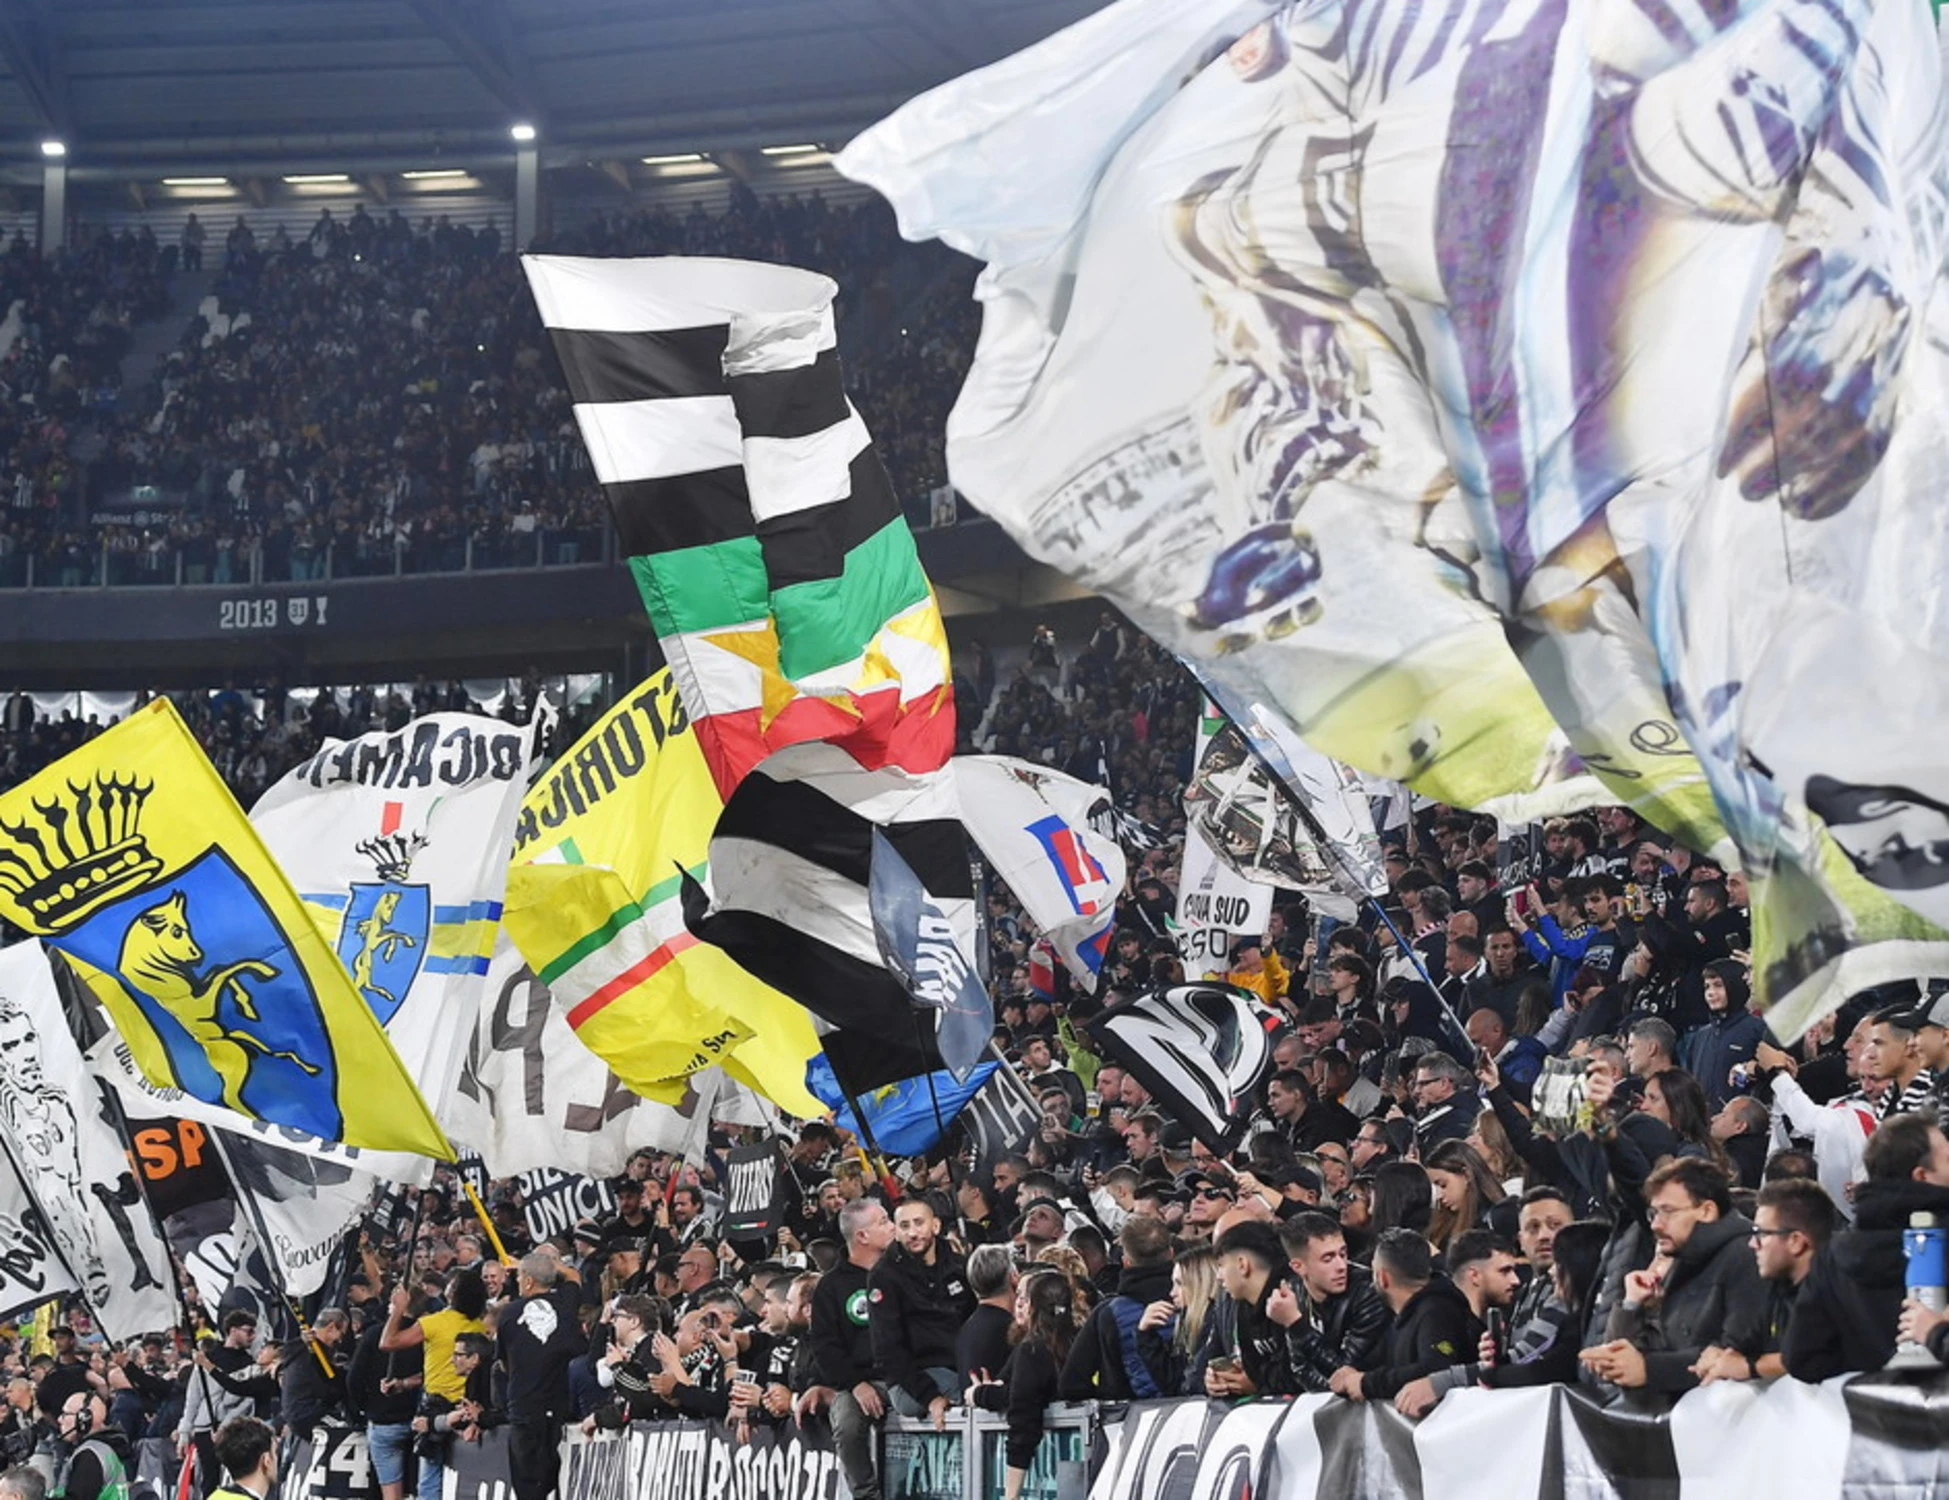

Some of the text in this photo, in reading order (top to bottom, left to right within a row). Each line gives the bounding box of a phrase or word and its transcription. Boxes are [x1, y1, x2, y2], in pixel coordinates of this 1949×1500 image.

[220, 599, 277, 628] 2013
[1213, 894, 1251, 927] SUD
[309, 1427, 372, 1489] 24
